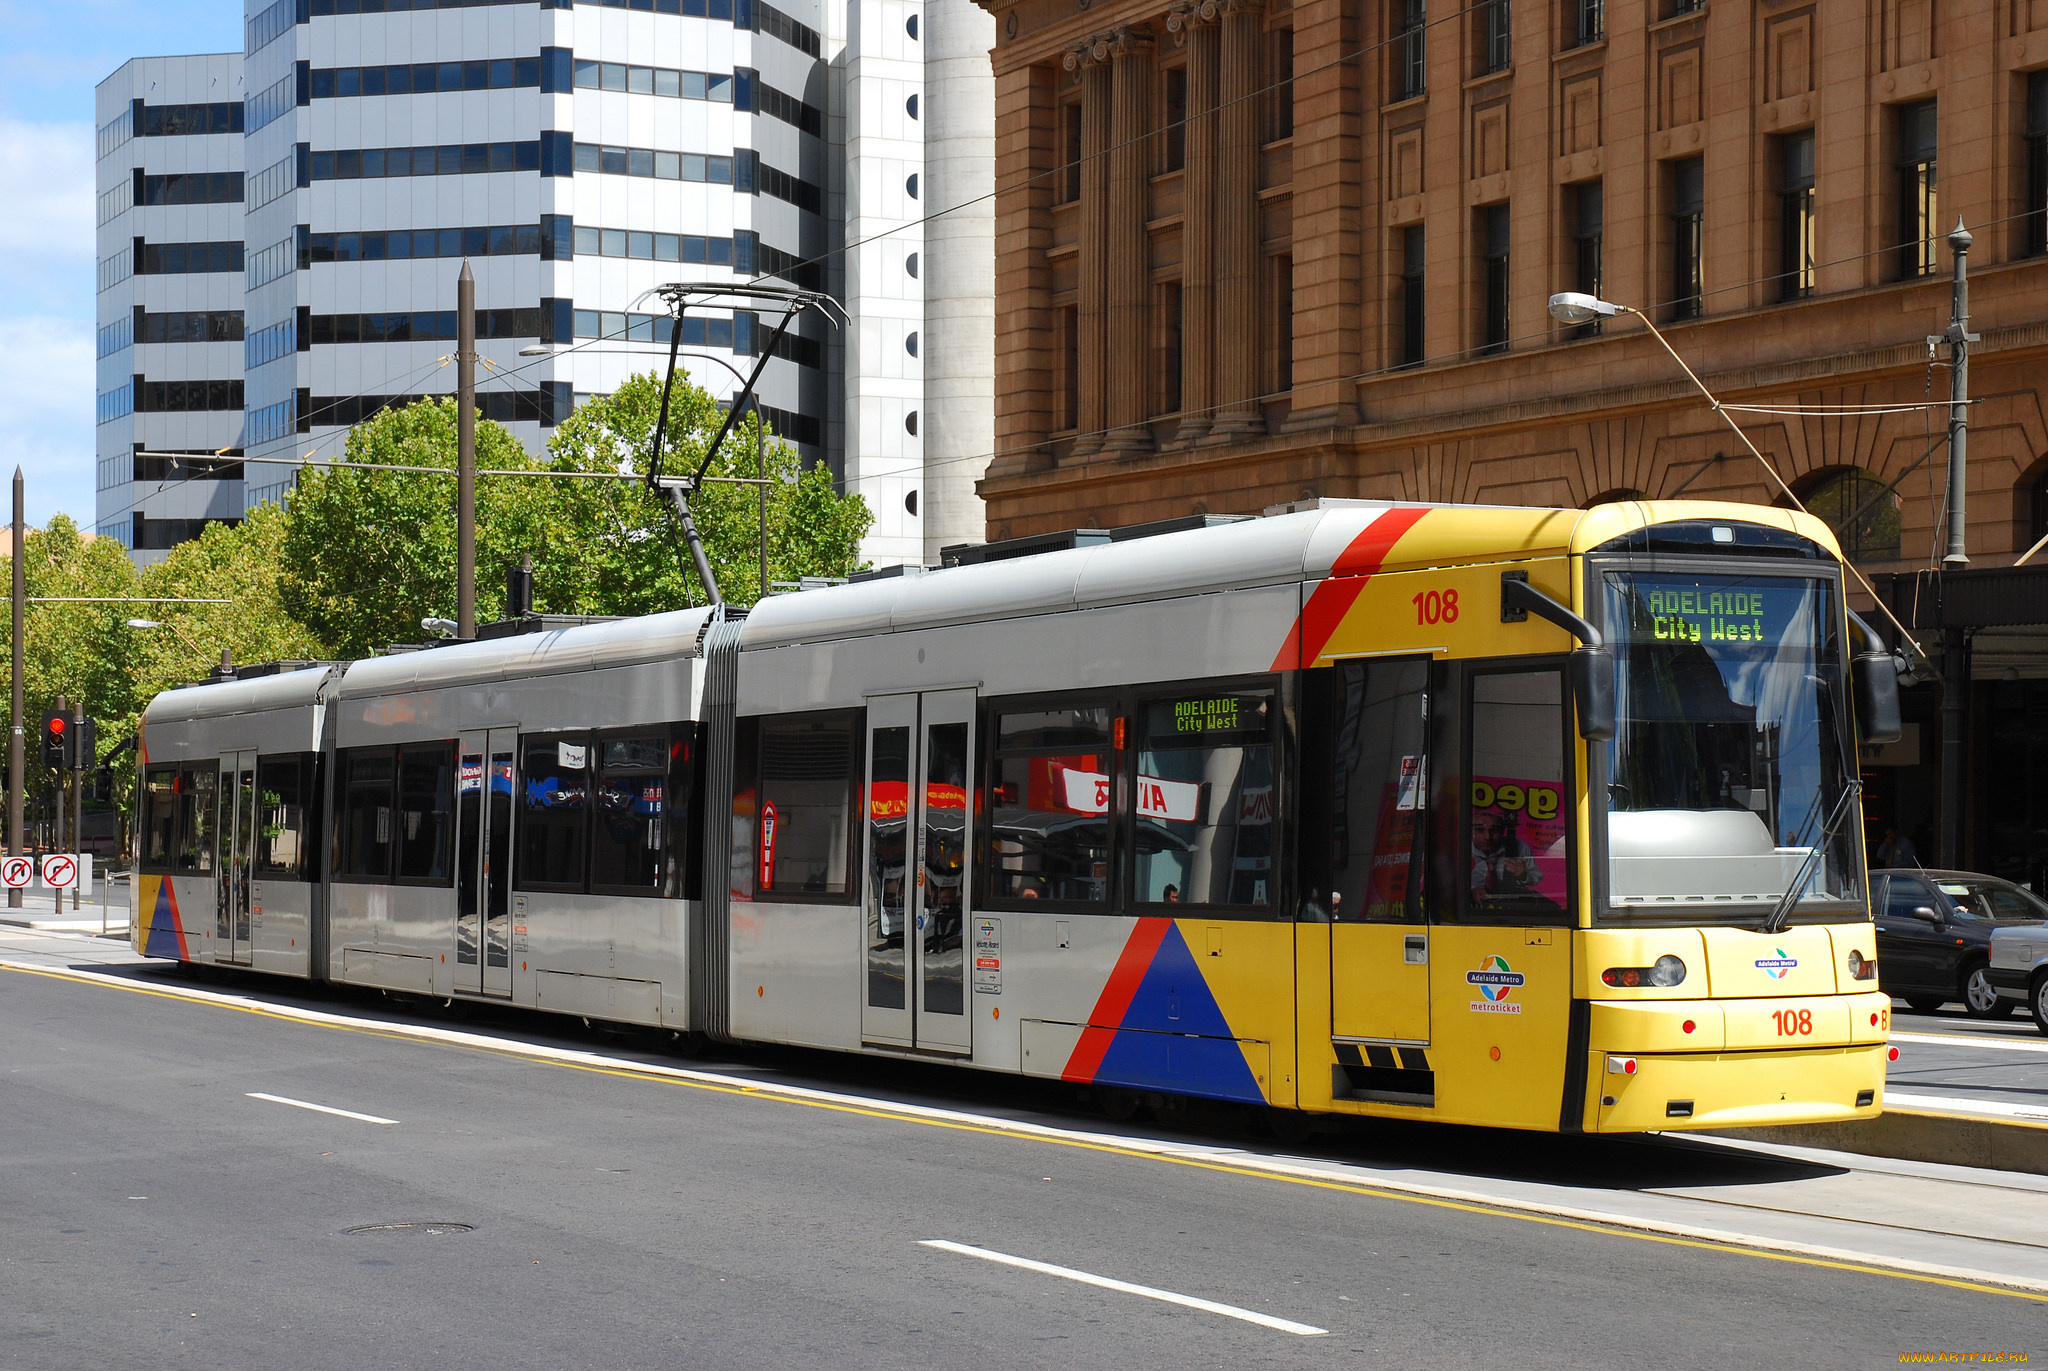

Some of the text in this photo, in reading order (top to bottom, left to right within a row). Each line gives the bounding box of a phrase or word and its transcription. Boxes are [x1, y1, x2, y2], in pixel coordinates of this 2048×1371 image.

[1412, 588, 1459, 625] 108
[1649, 591, 1764, 615] ADELAIDE
[1654, 616, 1763, 642] City West
[1175, 697, 1239, 717] ADELAIDE
[1177, 713, 1238, 732] City West
[1471, 974, 1520, 983] Adelaide Metro
[1471, 1003, 1520, 1013] metroticket
[1771, 1008, 1813, 1037] 108
